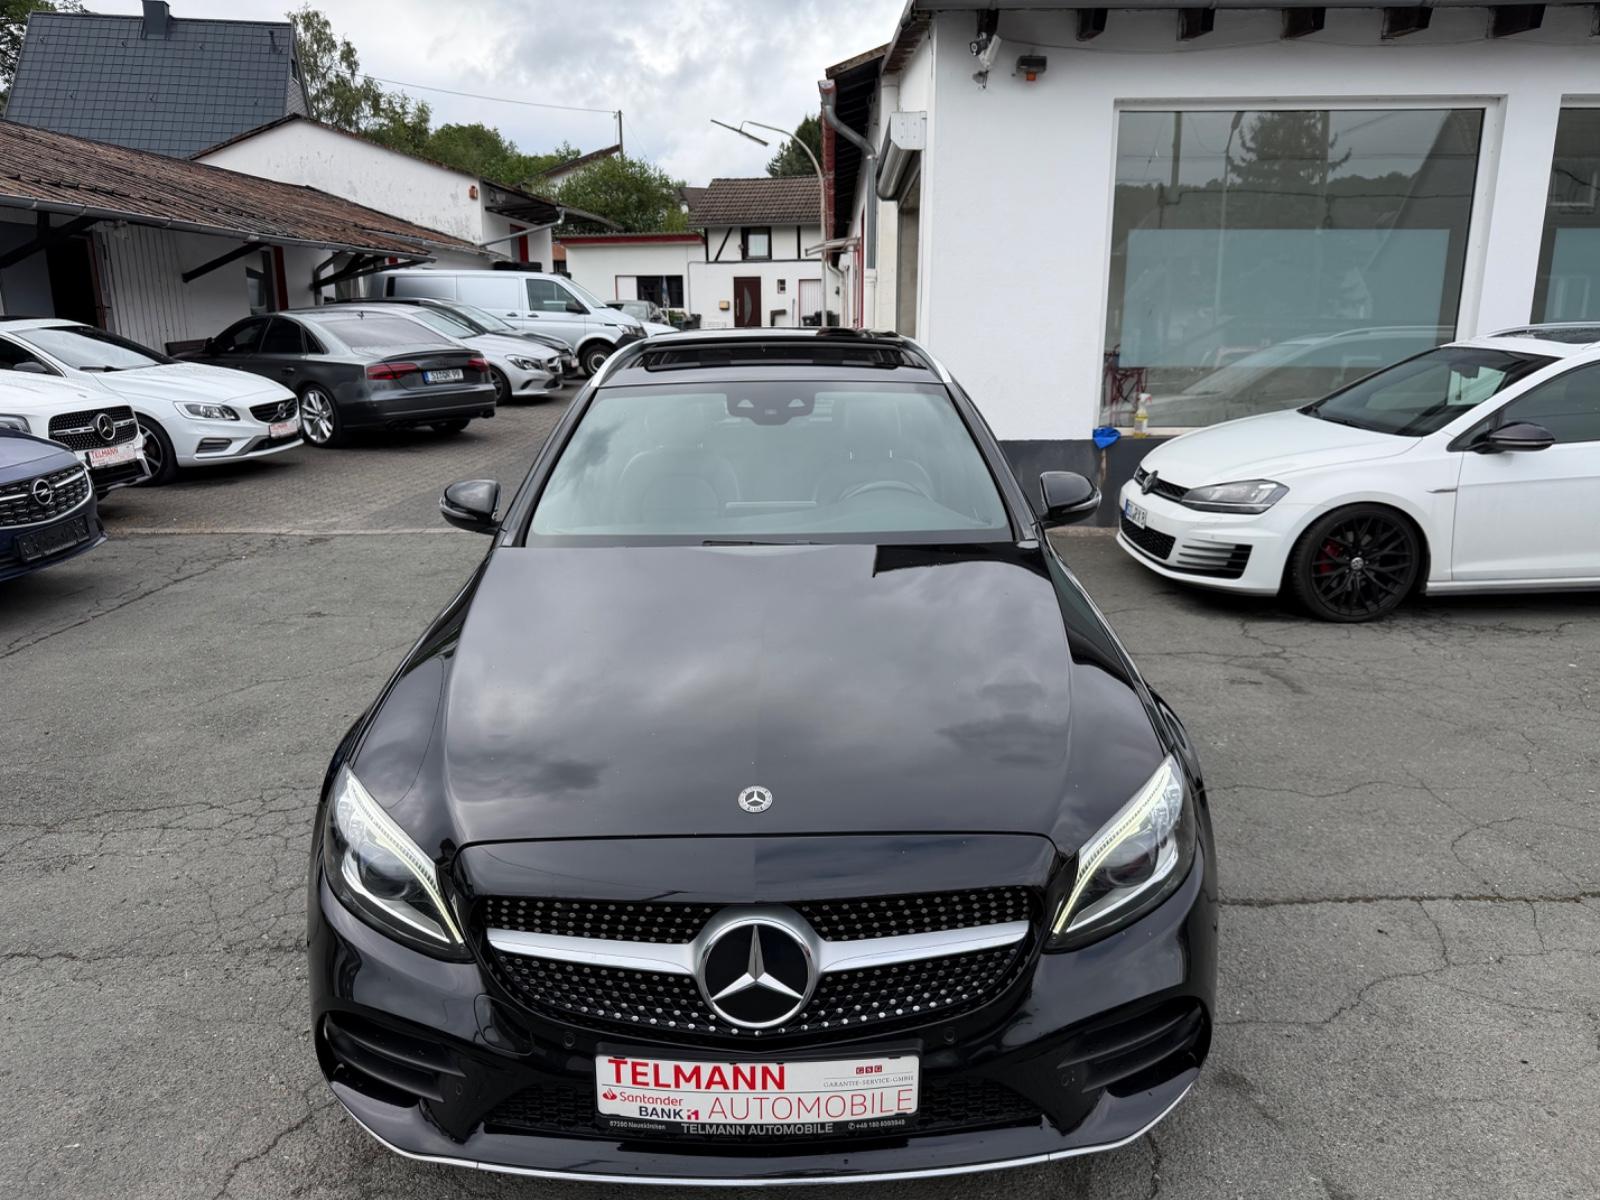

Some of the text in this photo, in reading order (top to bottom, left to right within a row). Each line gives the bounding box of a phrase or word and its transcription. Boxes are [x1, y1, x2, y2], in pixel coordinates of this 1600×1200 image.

[608, 1058, 785, 1091] TELMANN
[619, 1091, 684, 1107] Santander
[708, 1089, 913, 1121] AUTOMOBILE
[639, 1106, 684, 1120] BANK
[681, 1122, 834, 1136] TELMANN AUTOMOBILE
